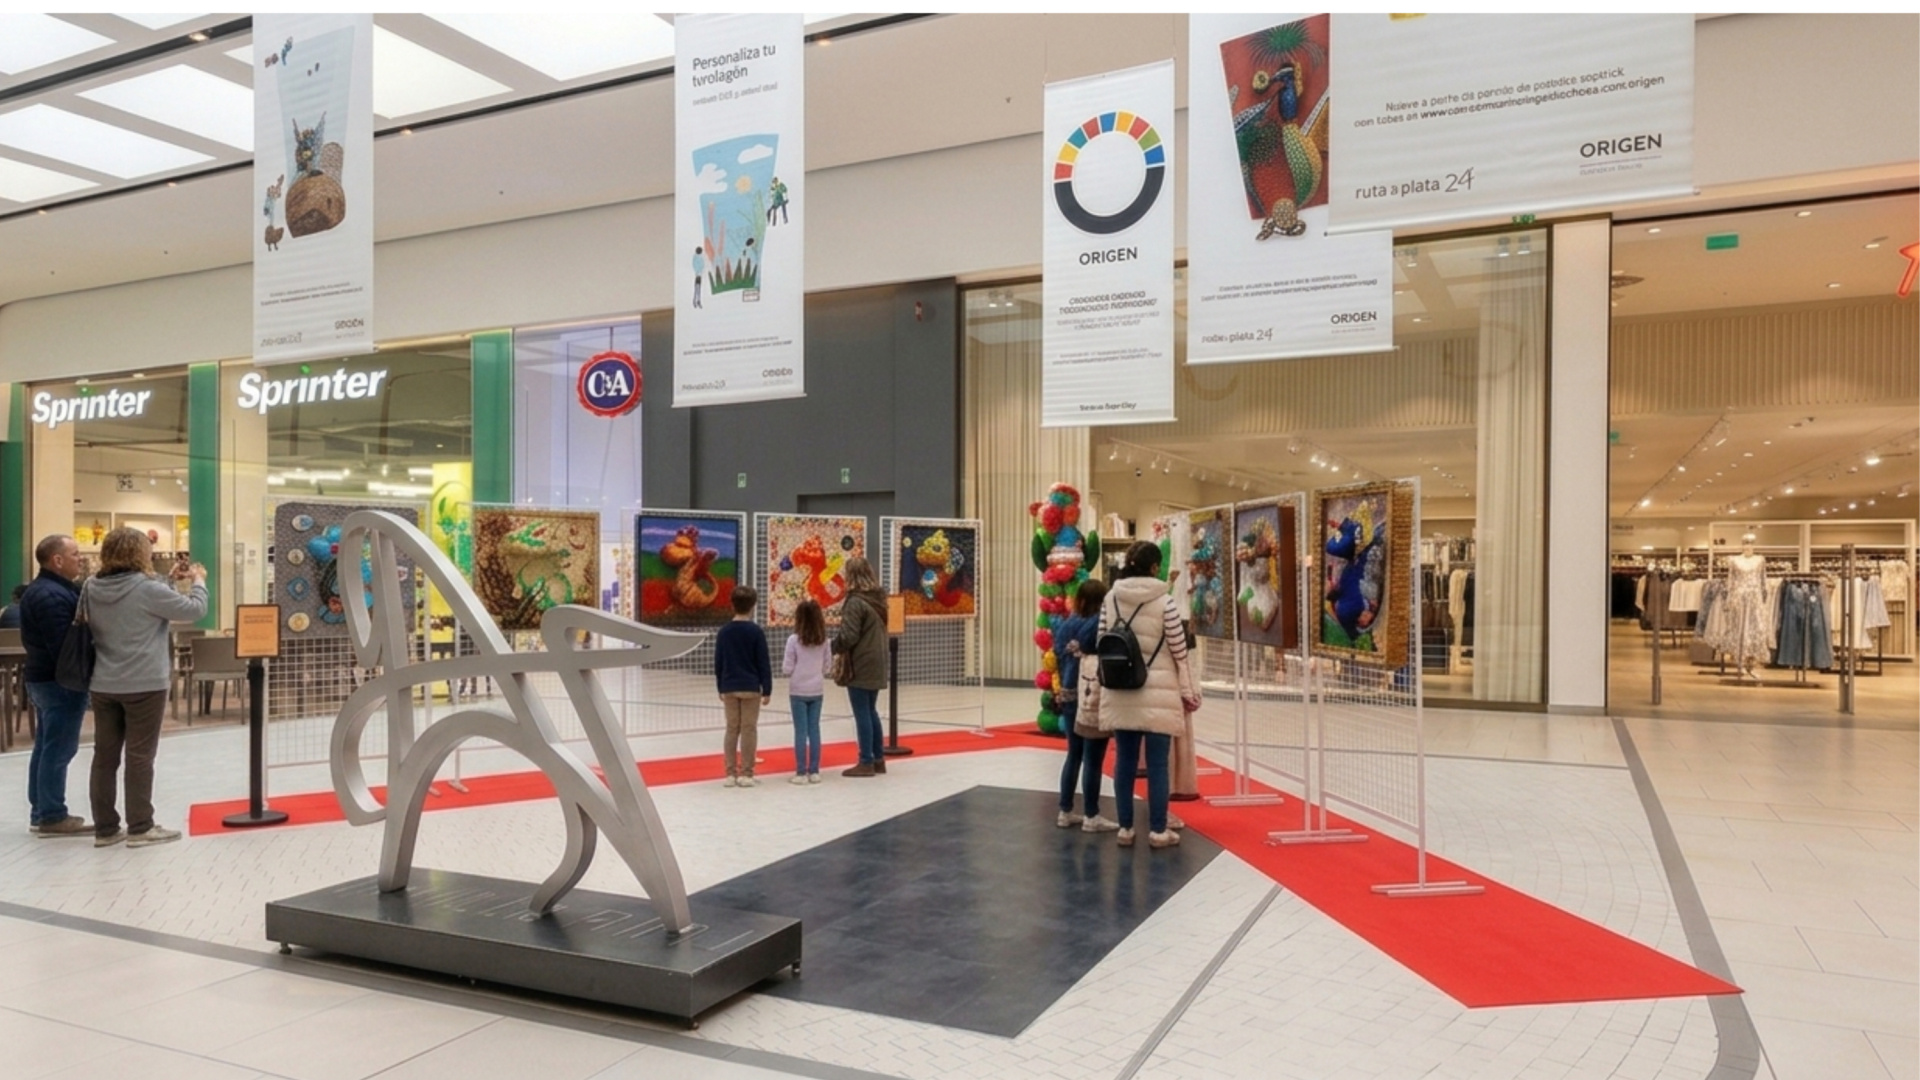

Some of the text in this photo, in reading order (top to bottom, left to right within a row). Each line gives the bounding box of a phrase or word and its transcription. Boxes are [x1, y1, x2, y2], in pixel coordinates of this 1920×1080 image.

[692, 44, 776, 71] Personaliza tu
[1579, 133, 1663, 159] ORIGEN
[1356, 182, 1388, 199] ruta
[1400, 177, 1441, 198] plata
[1444, 166, 1475, 194] 24
[1079, 246, 1138, 266] ORIGEN
[237, 369, 388, 415] Sprinter
[31, 388, 151, 430] Sprinter
